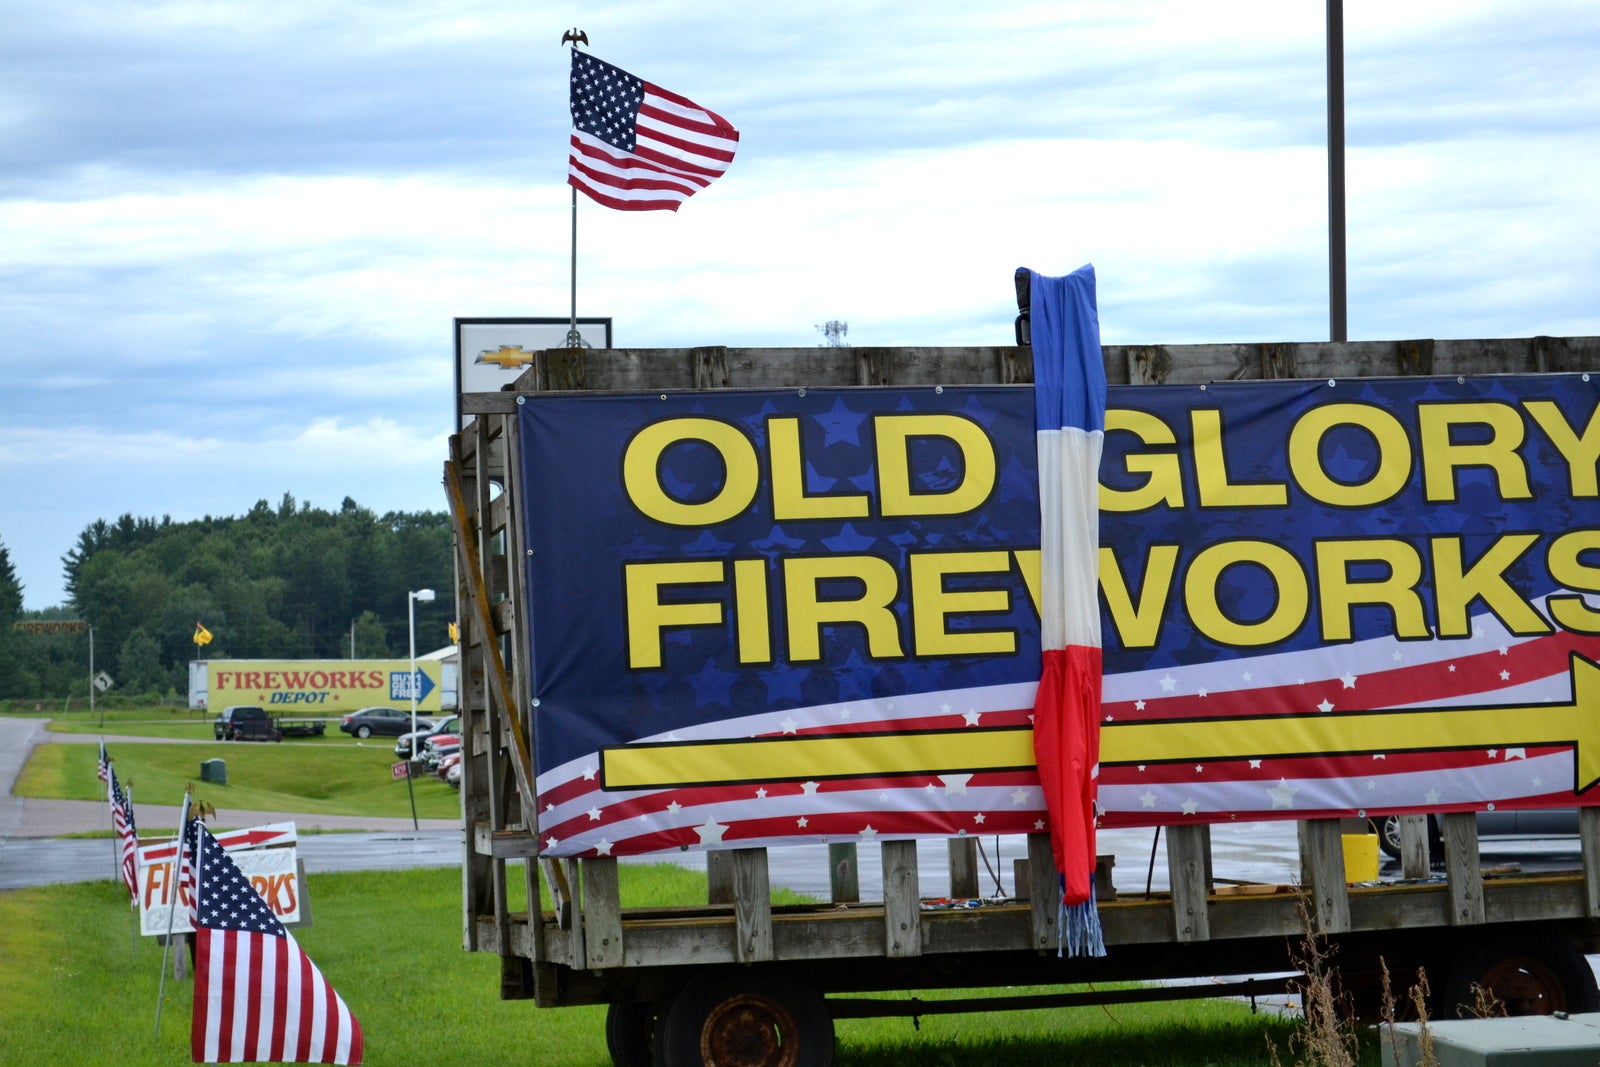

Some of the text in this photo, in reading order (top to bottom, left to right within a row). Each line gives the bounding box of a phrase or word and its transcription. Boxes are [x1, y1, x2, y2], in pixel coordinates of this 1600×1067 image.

[621, 398, 1600, 527] OLD GLORY
[623, 529, 1600, 670] FIREWORKS
[216, 670, 385, 690] FIREWORKS
[392, 674, 421, 682] BUY 1
[269, 691, 330, 704] DEPOT
[392, 690, 421, 698] FREE
